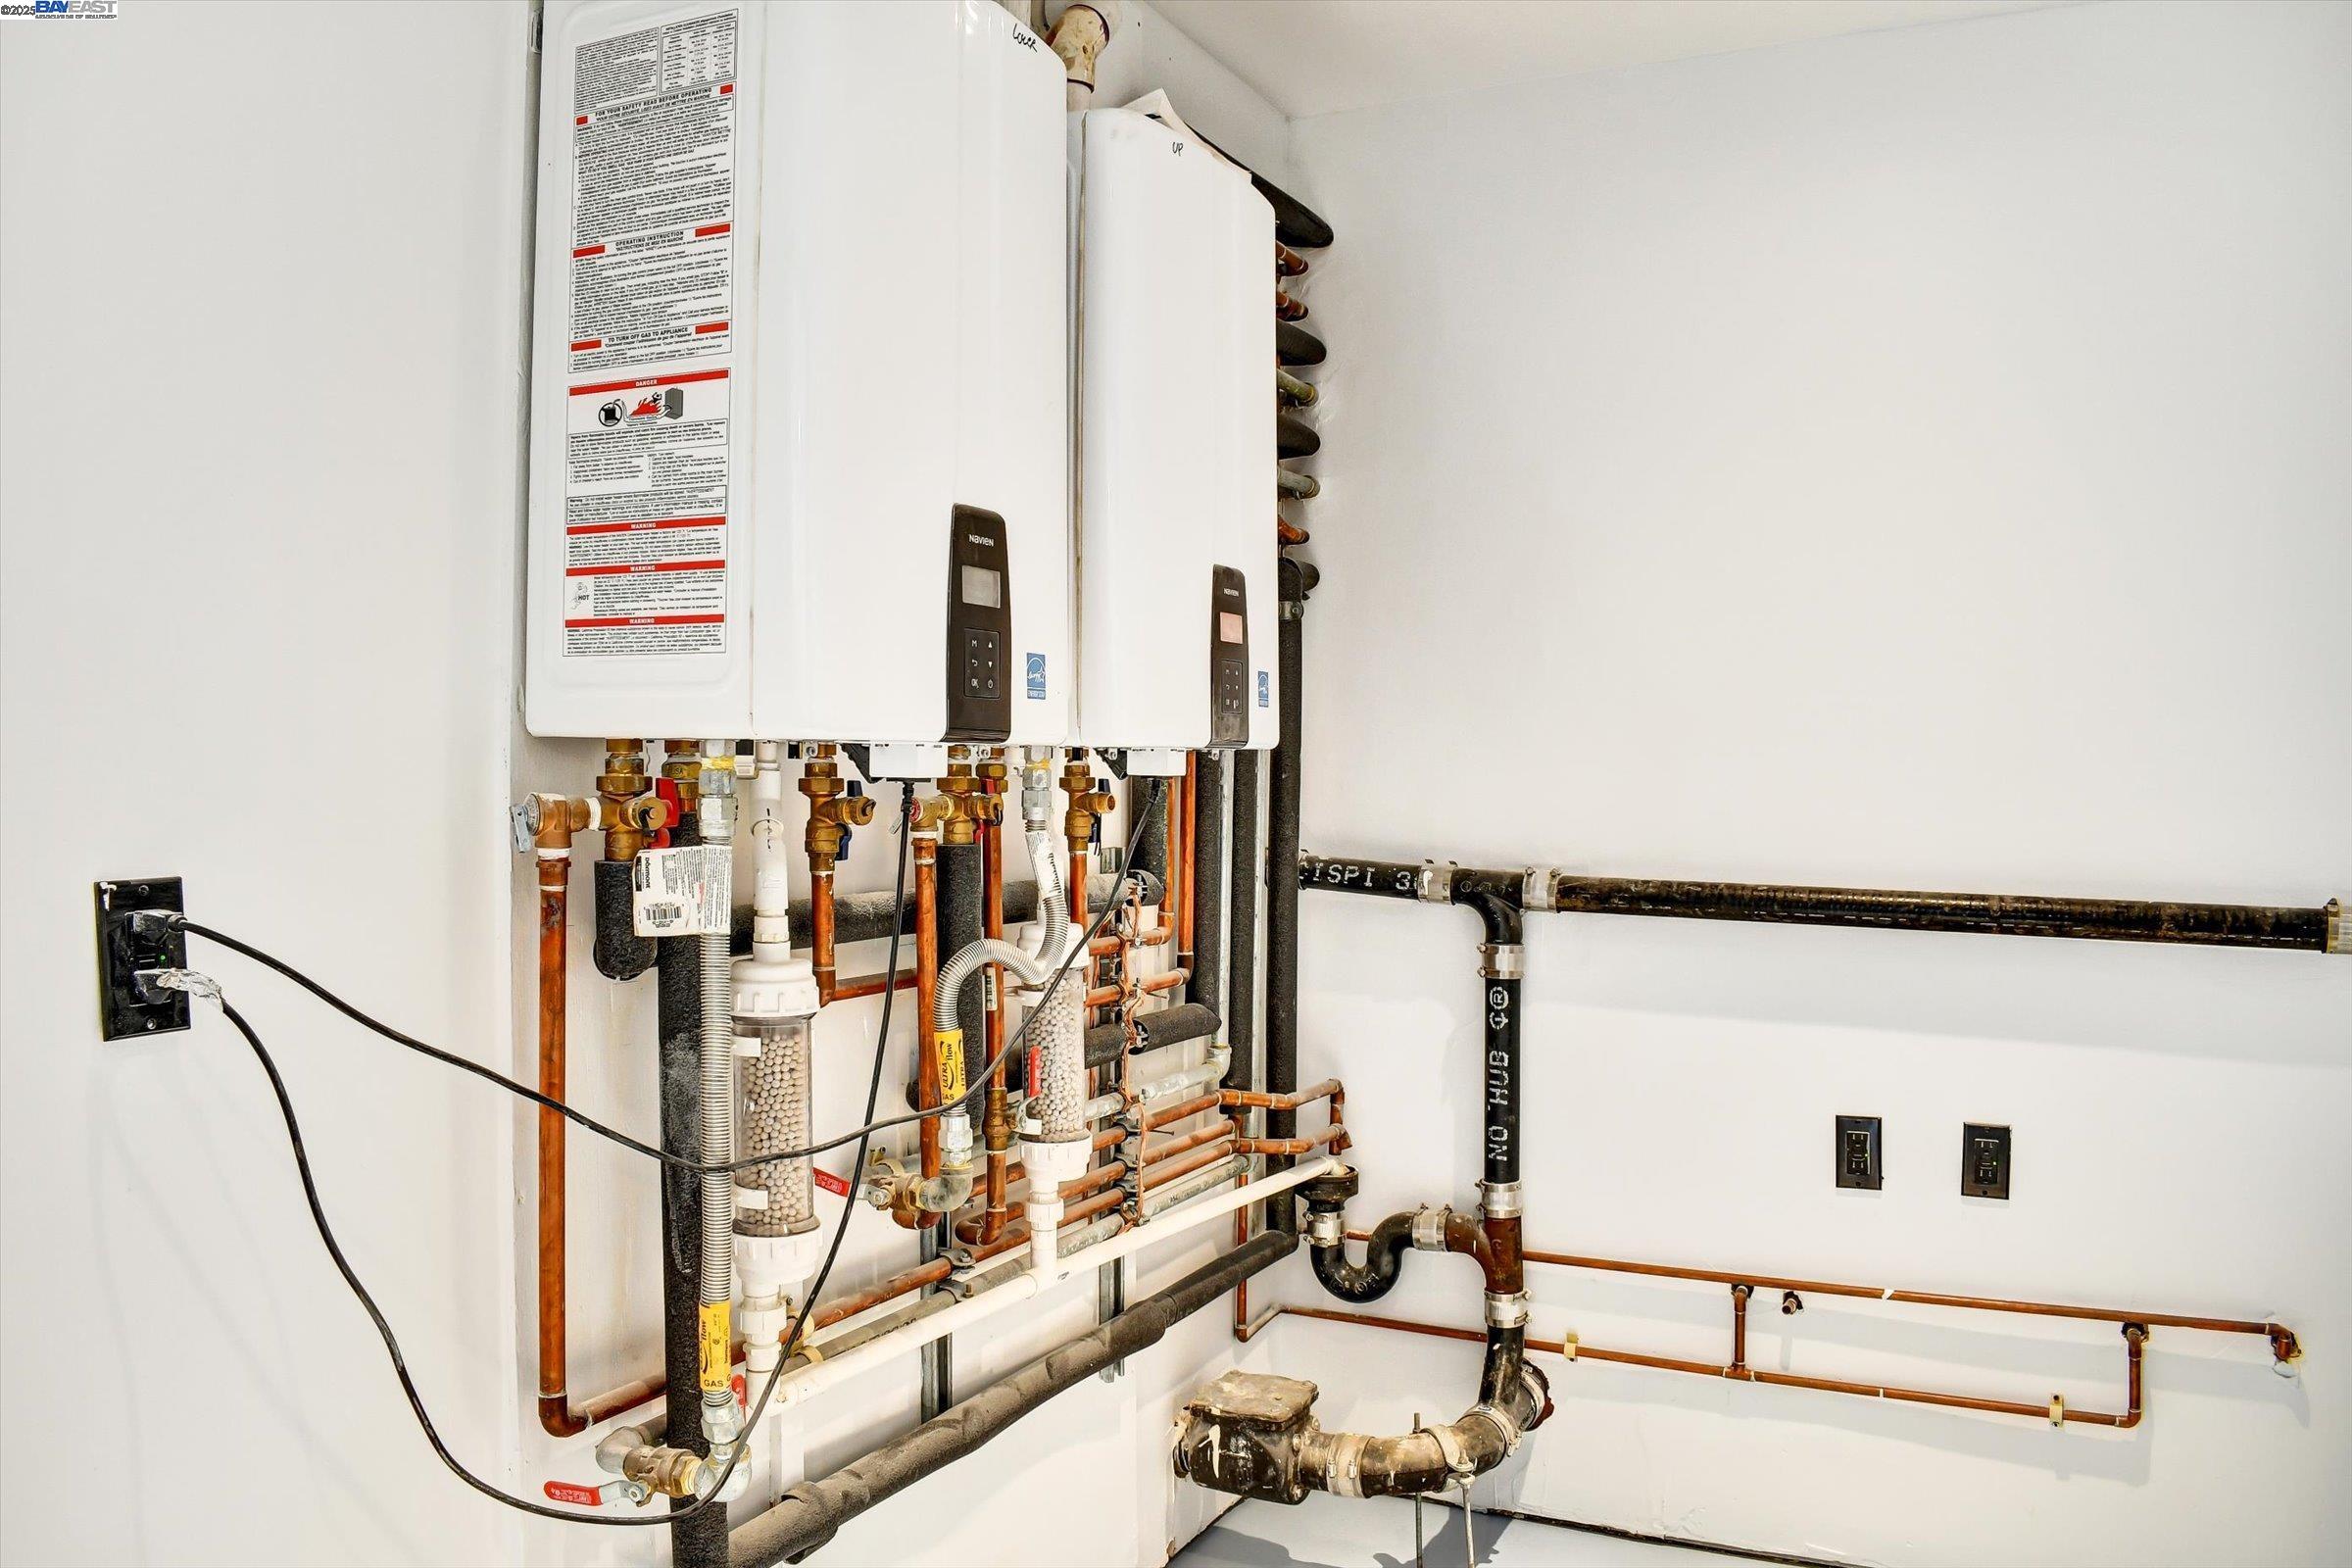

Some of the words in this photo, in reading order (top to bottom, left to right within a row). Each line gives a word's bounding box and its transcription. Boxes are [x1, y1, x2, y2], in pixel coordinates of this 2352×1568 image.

[1489, 1051, 1509, 1105] HUB
[1489, 1125, 1508, 1161] NO
[704, 1379, 724, 1388] GAS
